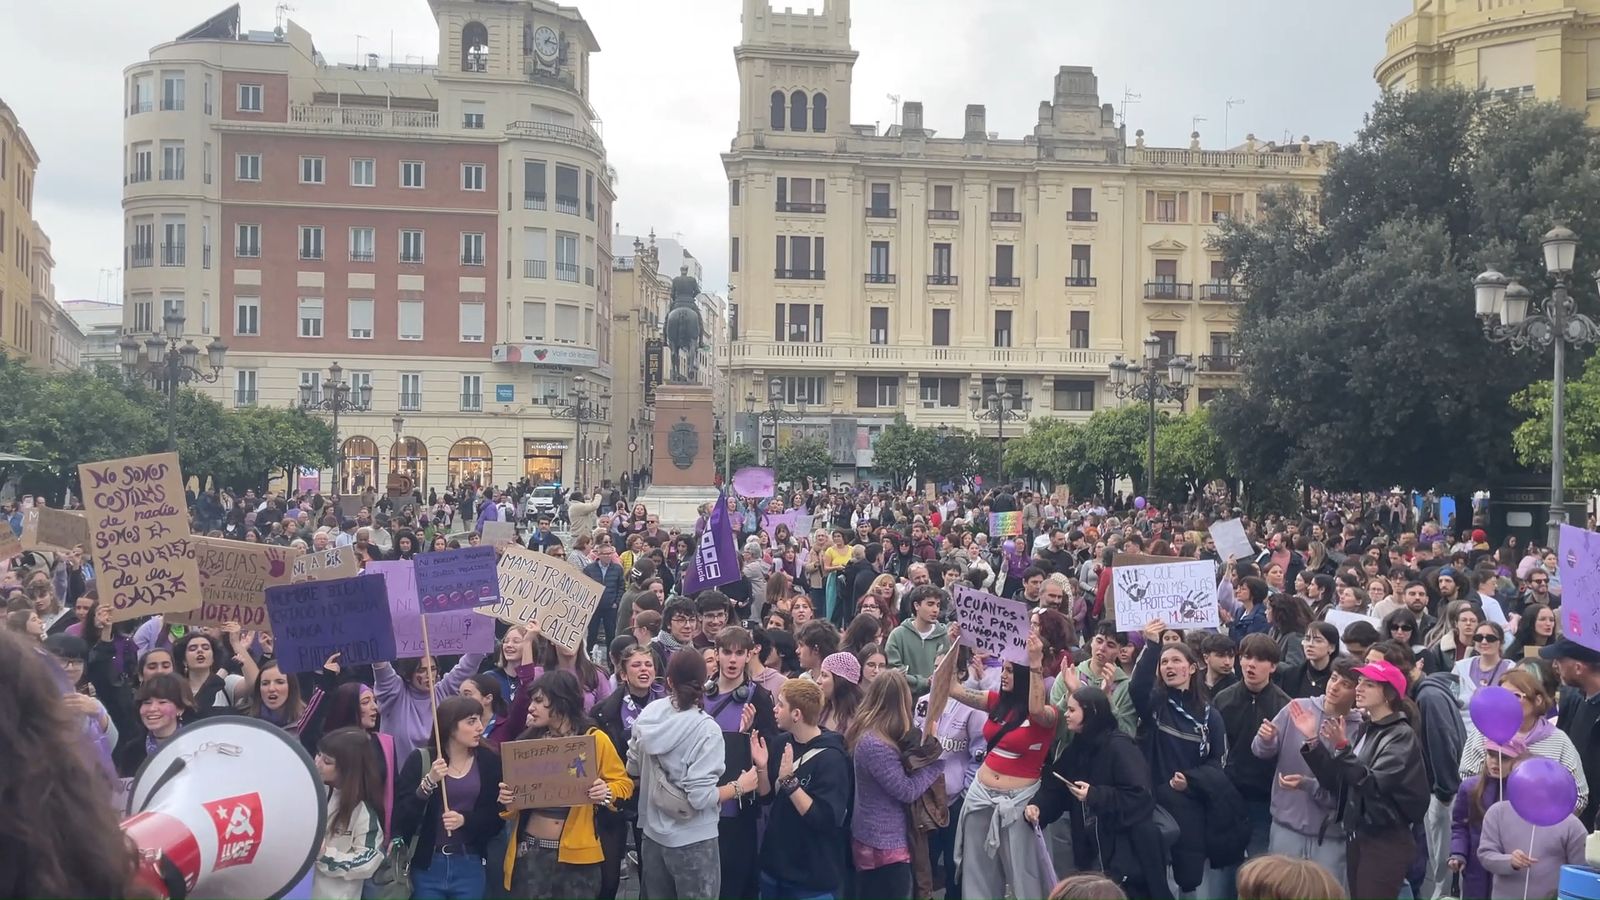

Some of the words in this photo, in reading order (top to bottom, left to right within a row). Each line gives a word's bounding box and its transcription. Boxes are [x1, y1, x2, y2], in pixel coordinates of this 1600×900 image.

[100, 514, 126, 529] de
[134, 502, 179, 522] nadie
[145, 521, 171, 540] EL
[98, 538, 196, 573] ESQUELETO
[113, 568, 139, 589] de
[541, 564, 597, 613] TRANQUILA
[498, 572, 516, 593] OY
[512, 577, 534, 600] NO
[533, 584, 562, 610] VOY
[557, 599, 588, 632] SOLA
[485, 596, 515, 617] OR
[541, 614, 580, 649] CALLE
[990, 617, 1020, 635] PARA
[1013, 637, 1027, 650] UN
